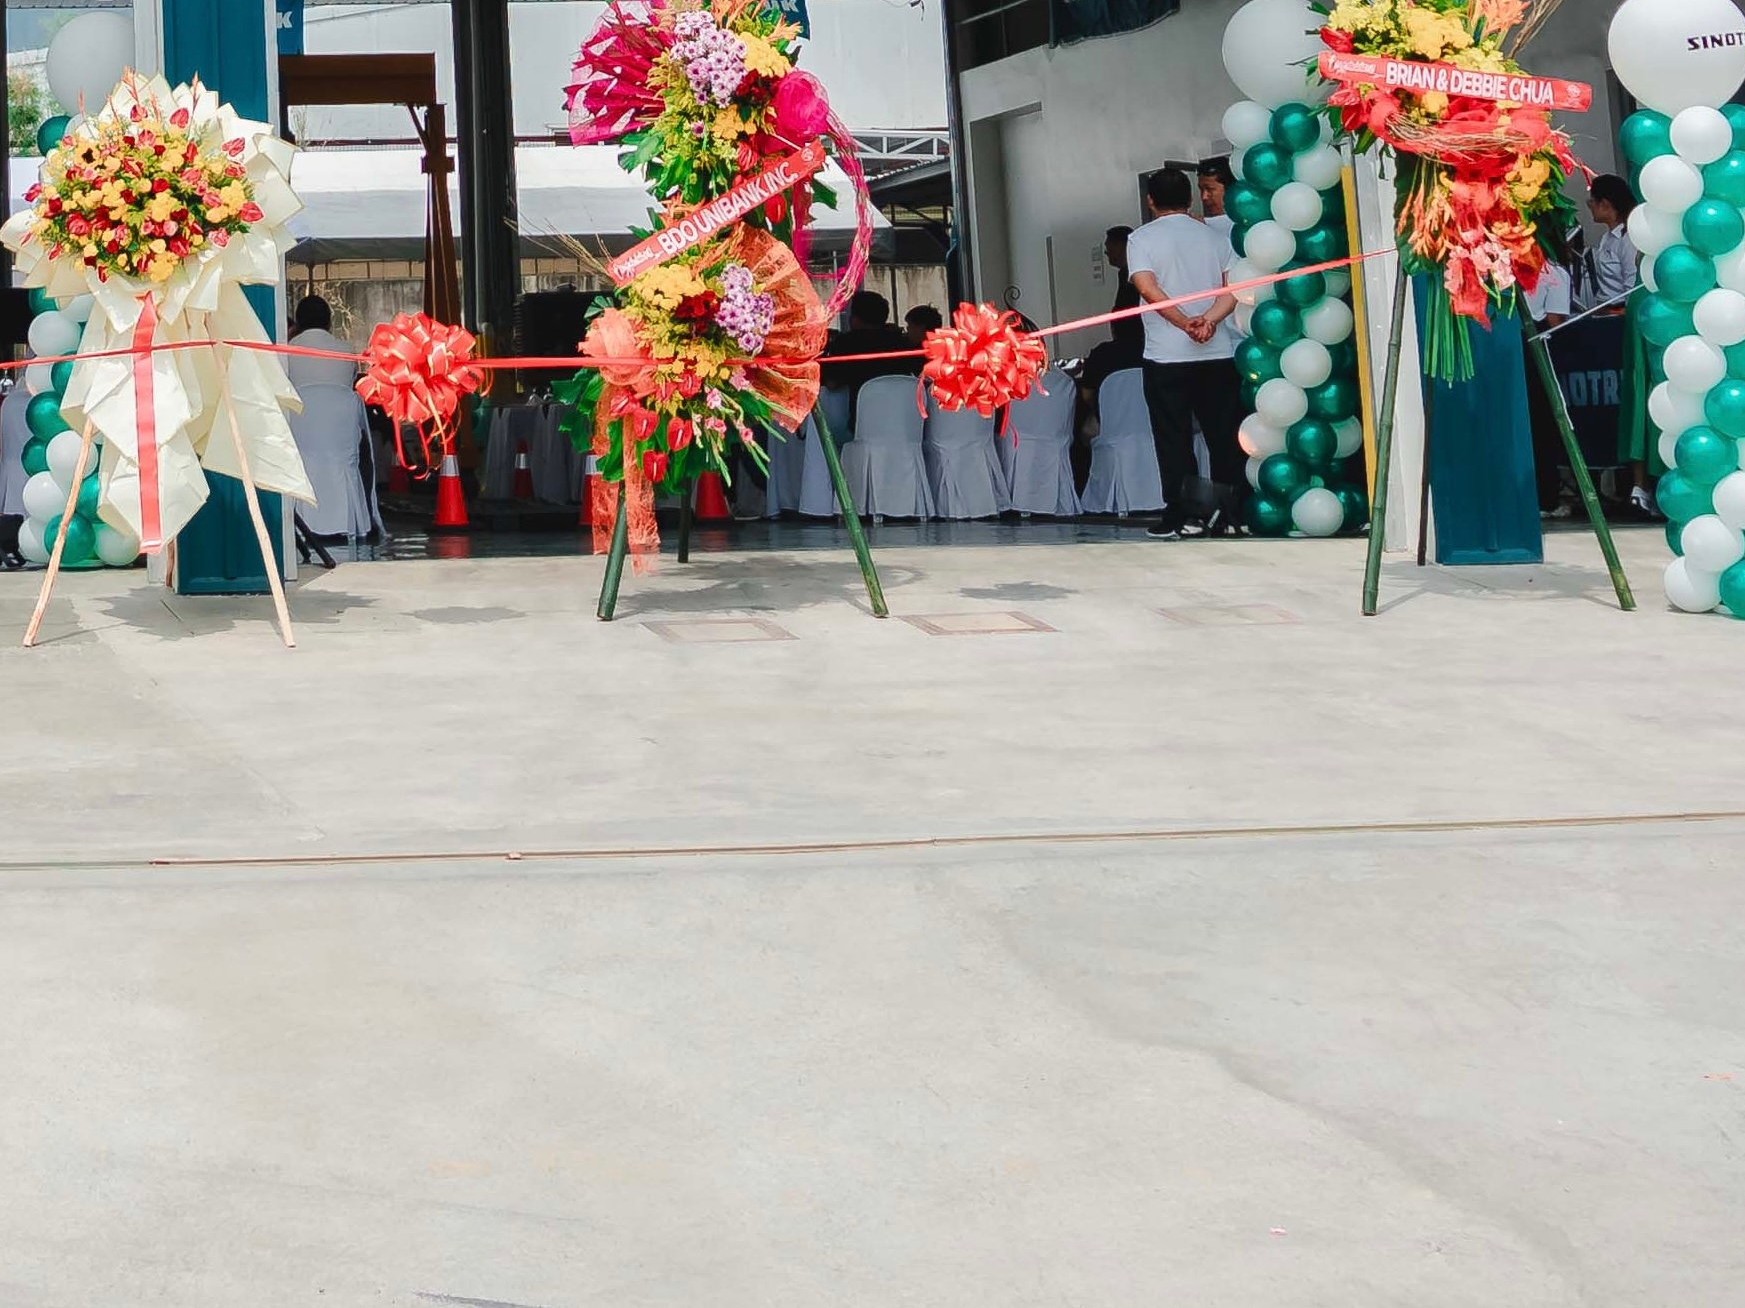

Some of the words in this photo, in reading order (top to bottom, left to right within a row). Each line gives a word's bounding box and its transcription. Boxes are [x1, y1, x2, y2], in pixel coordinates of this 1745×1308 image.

[1385, 62, 1437, 89] BRIAN
[1437, 72, 1449, 91] &
[1450, 73, 1508, 101] DEBBIE
[1508, 79, 1555, 105] CHUA
[657, 220, 699, 256] BDO
[695, 176, 768, 233] UNIBANK
[762, 161, 799, 195] INC.
